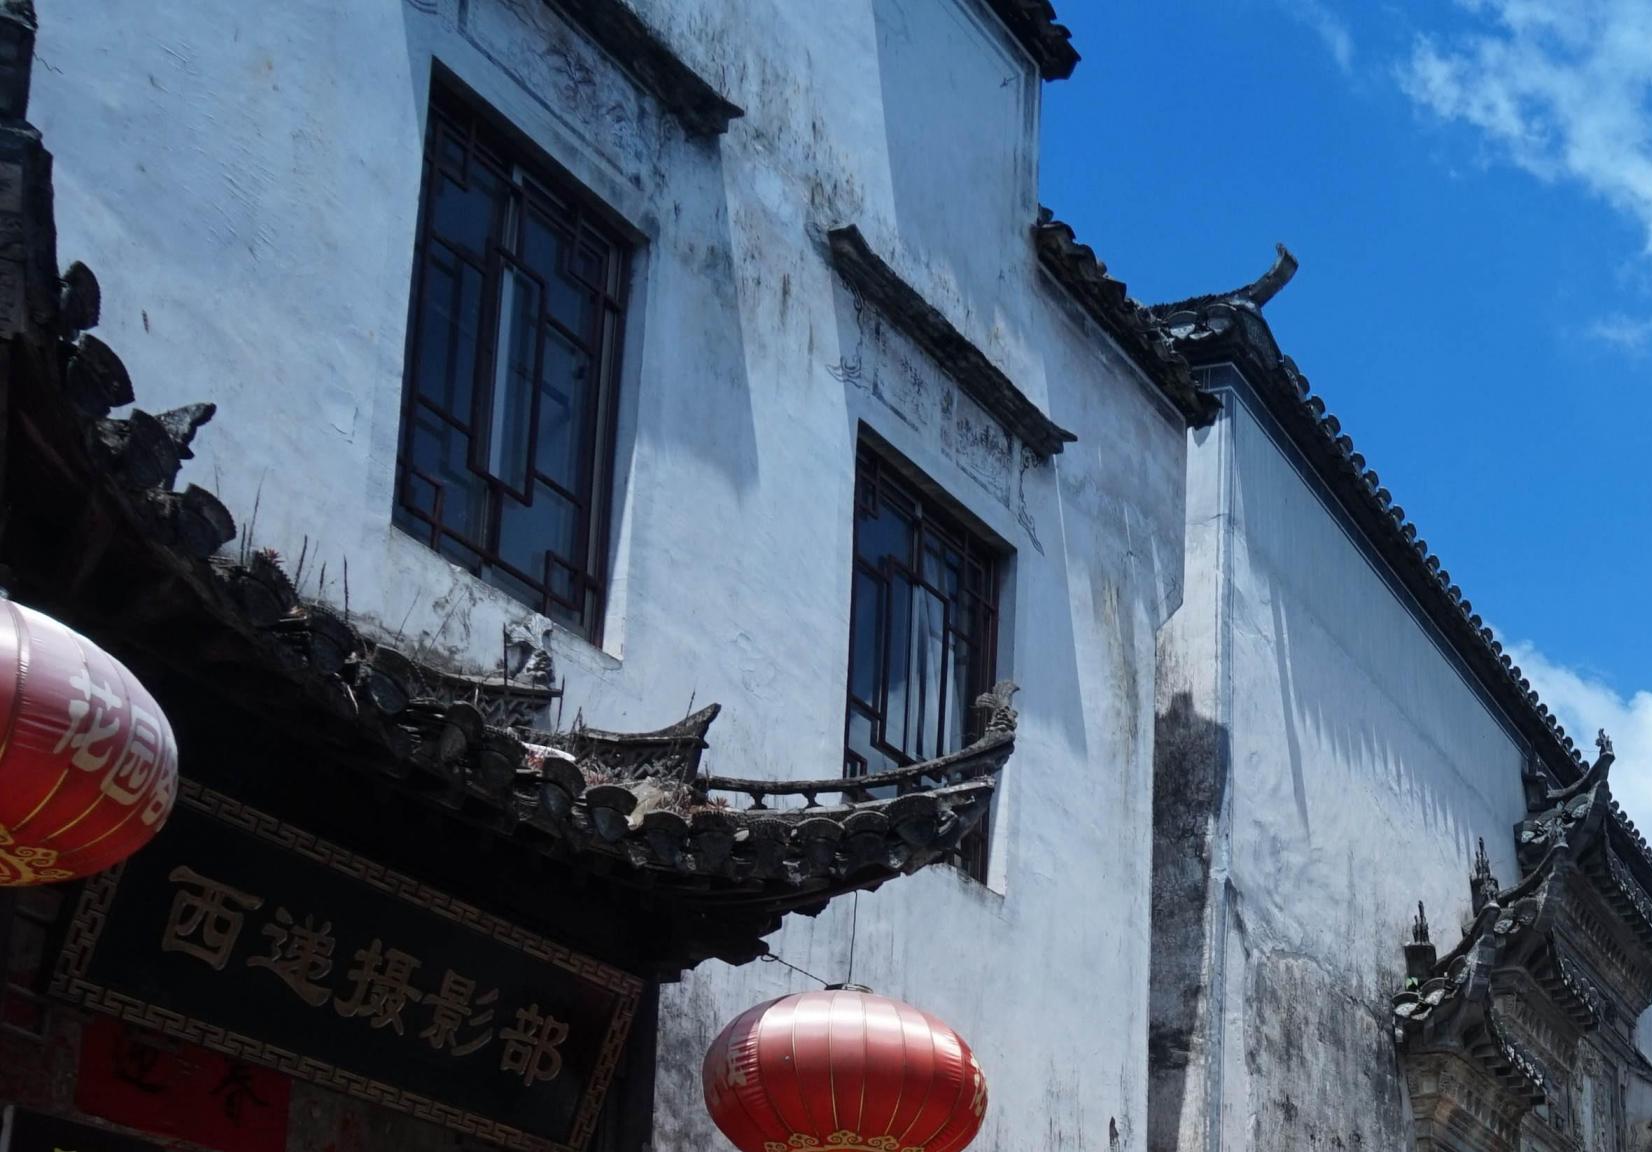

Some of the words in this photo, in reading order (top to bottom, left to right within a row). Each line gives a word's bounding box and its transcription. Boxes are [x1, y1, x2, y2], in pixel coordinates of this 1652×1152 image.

[161, 864, 570, 1087] 西递摄影部
